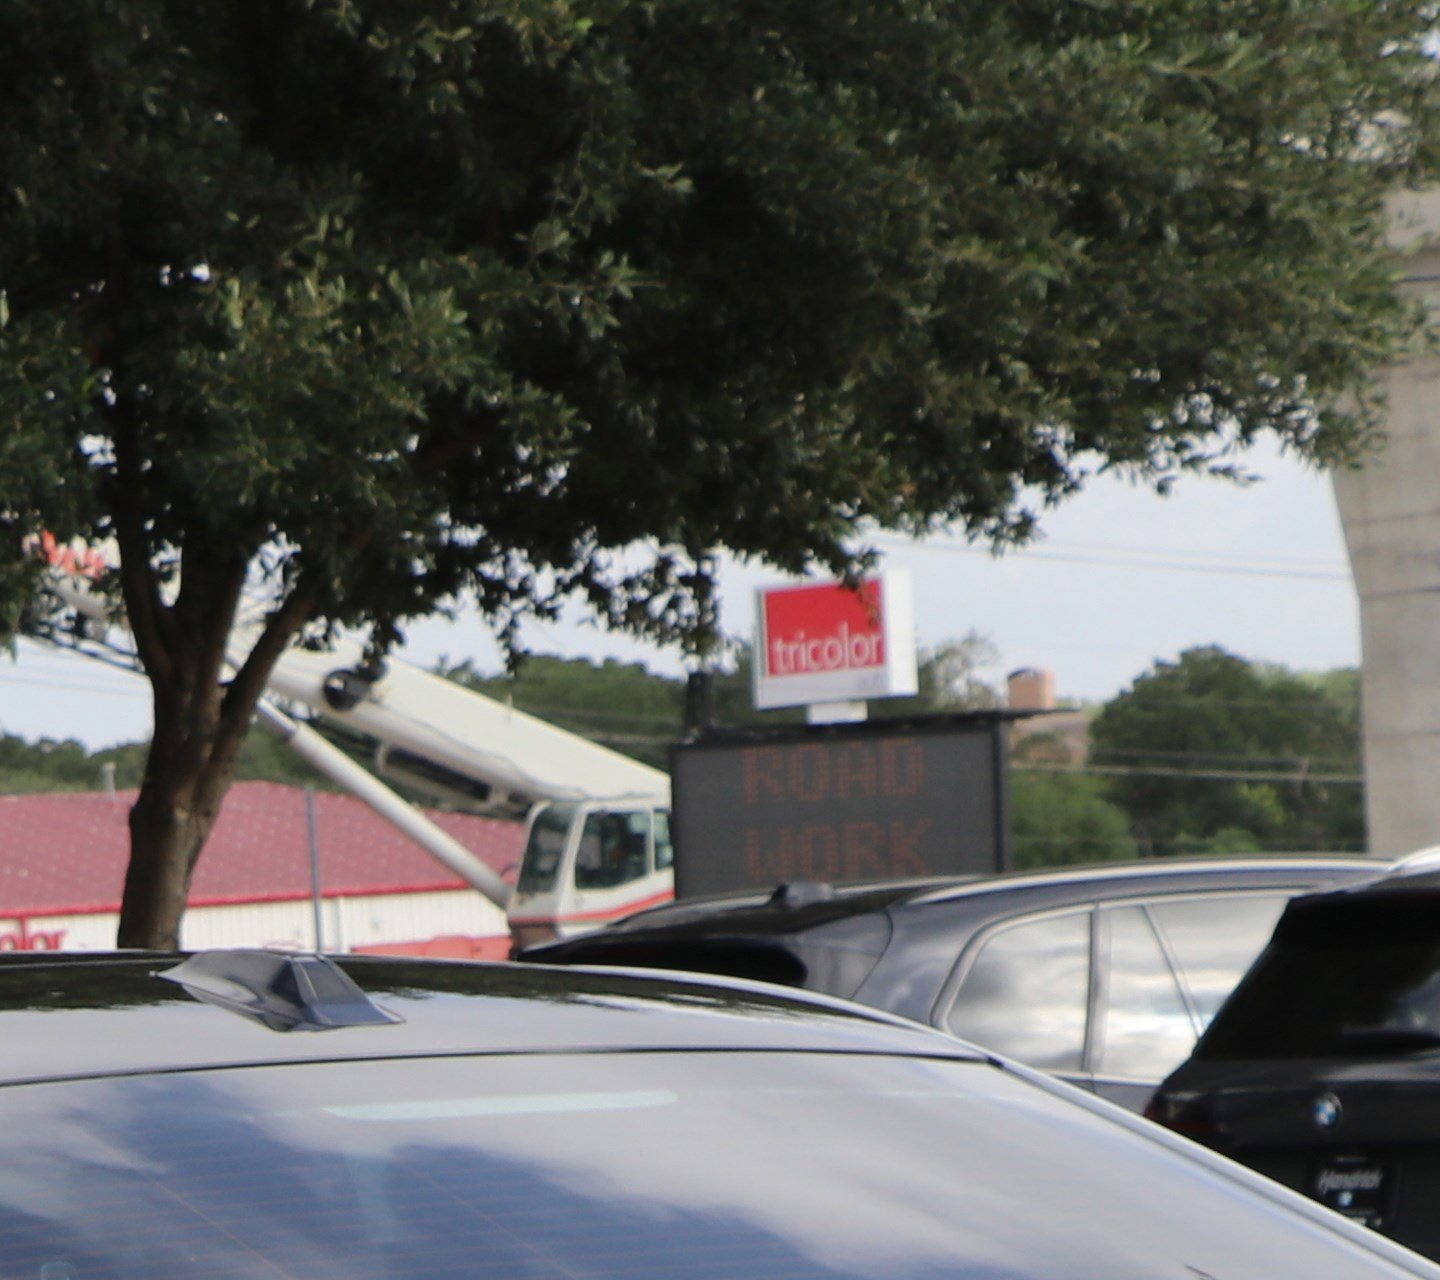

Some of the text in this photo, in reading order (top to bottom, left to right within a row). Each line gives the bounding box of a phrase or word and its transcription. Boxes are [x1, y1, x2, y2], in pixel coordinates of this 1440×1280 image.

[775, 620, 882, 673] tricolor
[742, 737, 925, 806] ROAD
[742, 818, 933, 885] WORK
